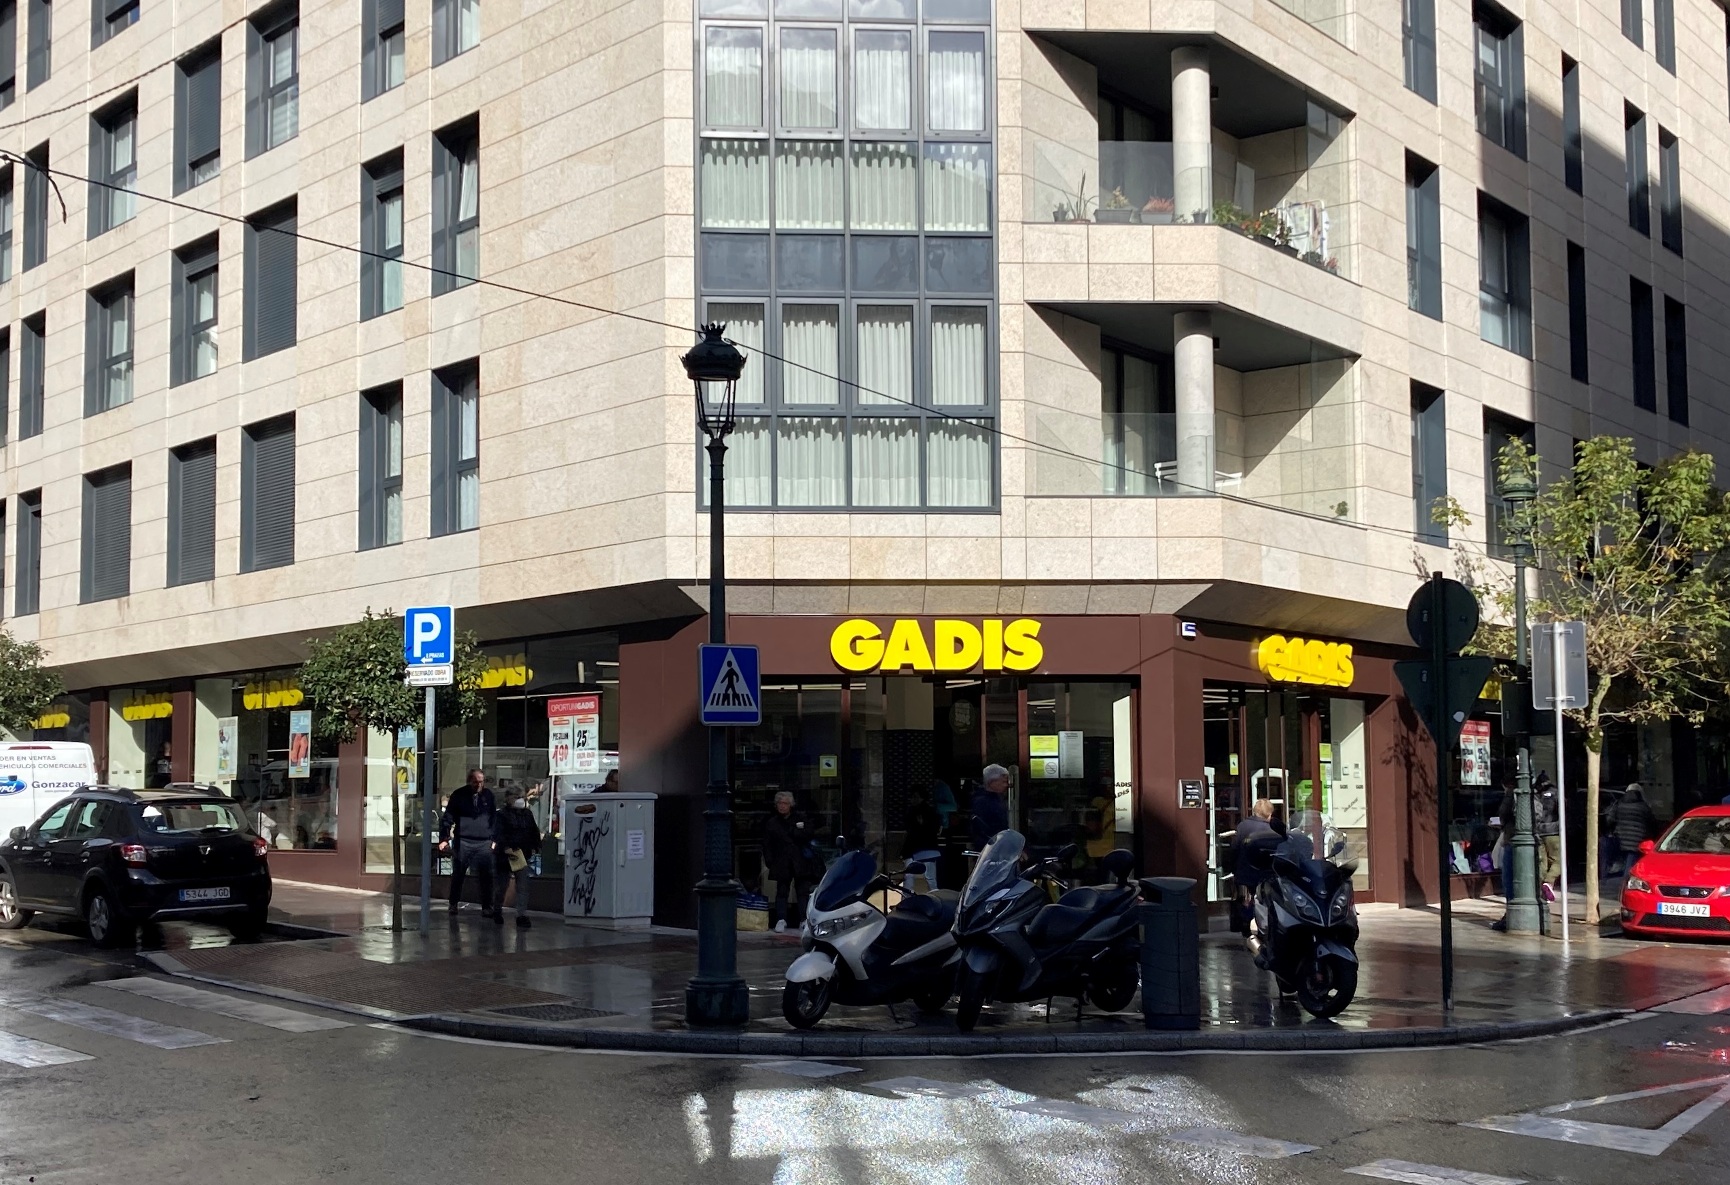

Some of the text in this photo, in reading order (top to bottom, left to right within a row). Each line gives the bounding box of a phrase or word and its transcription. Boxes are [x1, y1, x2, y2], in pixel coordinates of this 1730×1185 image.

[413, 613, 442, 657] P
[830, 618, 1043, 673] GADIS
[1257, 634, 1355, 688] GADIS
[31, 780, 87, 789] Gonzacar
[185, 887, 230, 899] 5344 JGD
[1663, 904, 1708, 915] 3946 JVZ
